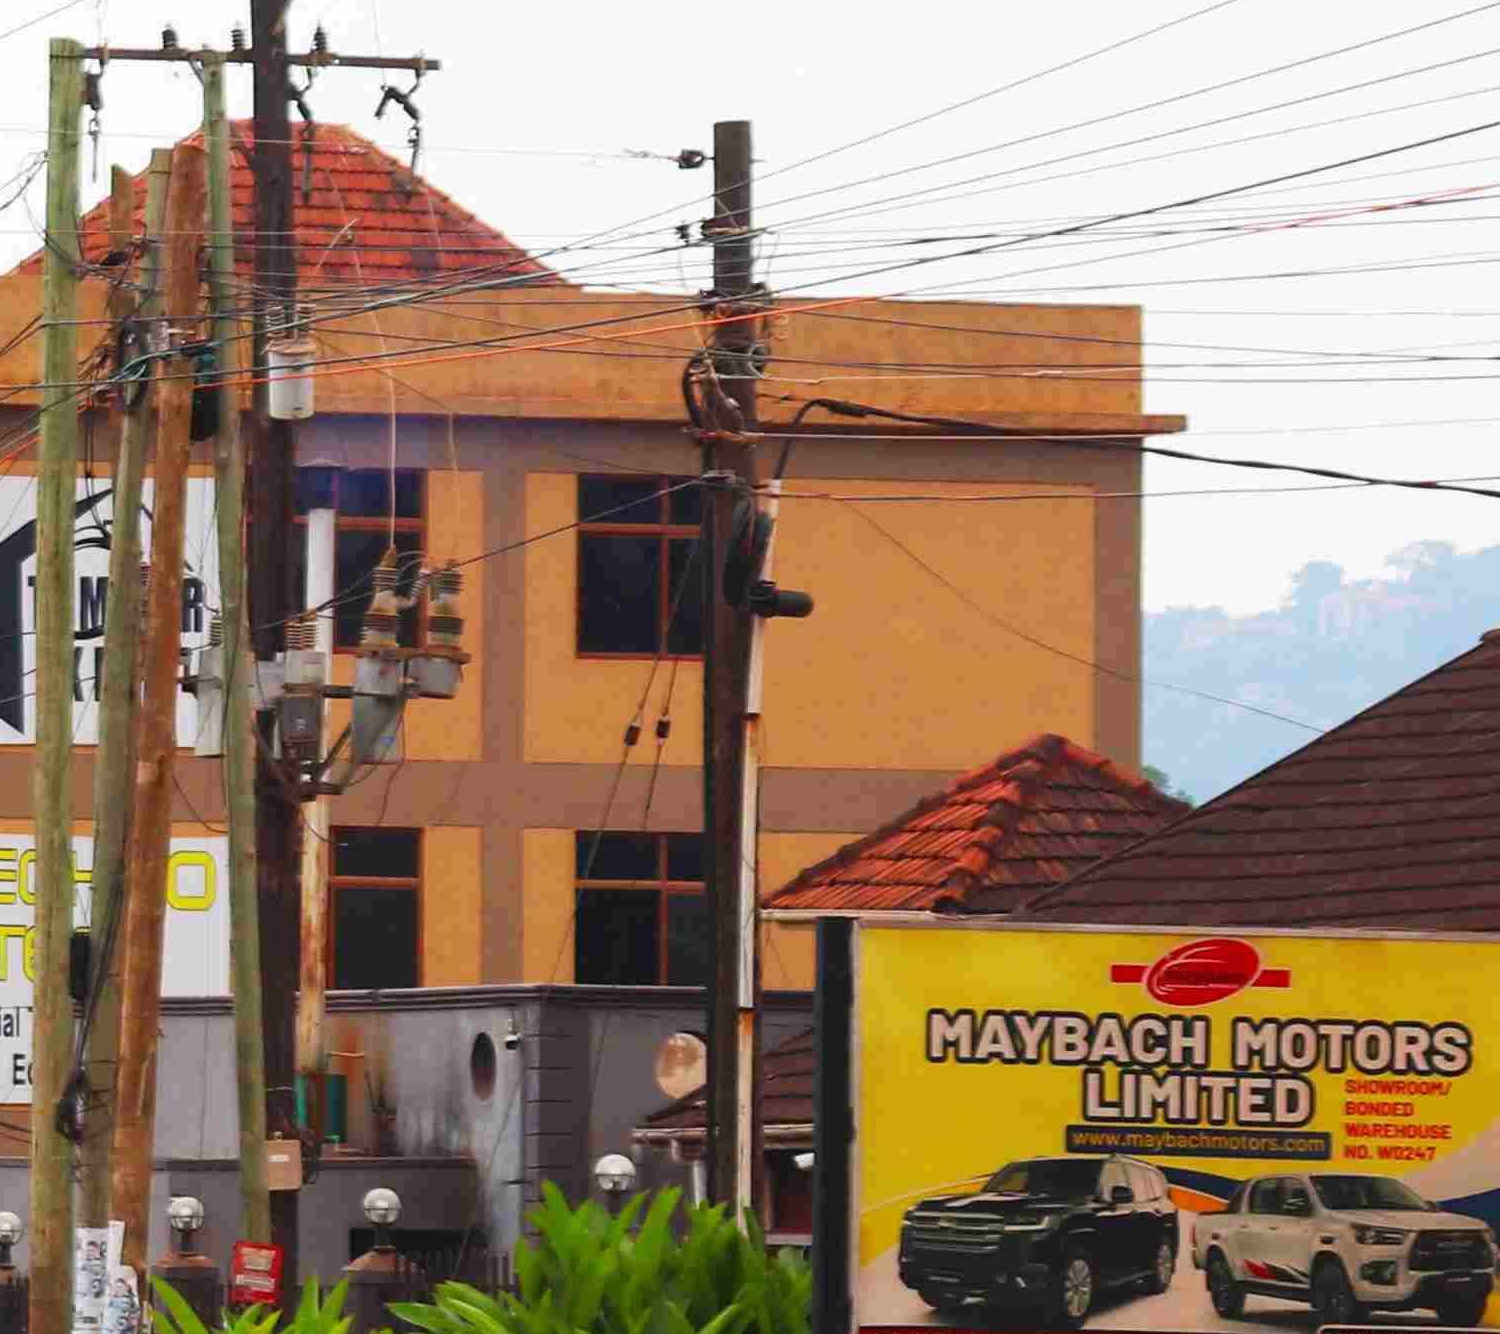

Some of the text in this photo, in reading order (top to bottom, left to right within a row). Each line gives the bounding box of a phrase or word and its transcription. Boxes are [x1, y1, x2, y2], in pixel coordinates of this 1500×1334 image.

[927, 1009, 1472, 1073] MAYBACH MOTORS
[1083, 1070, 1314, 1126] LIMITED
[1345, 1080, 1452, 1098] SHOWROOM/
[1345, 1102, 1415, 1118] BONDED
[1345, 1123, 1452, 1140] WAREHOUSE
[1073, 1131, 1326, 1153] www.maybachmotors.com
[1343, 1145, 1372, 1160] NO.
